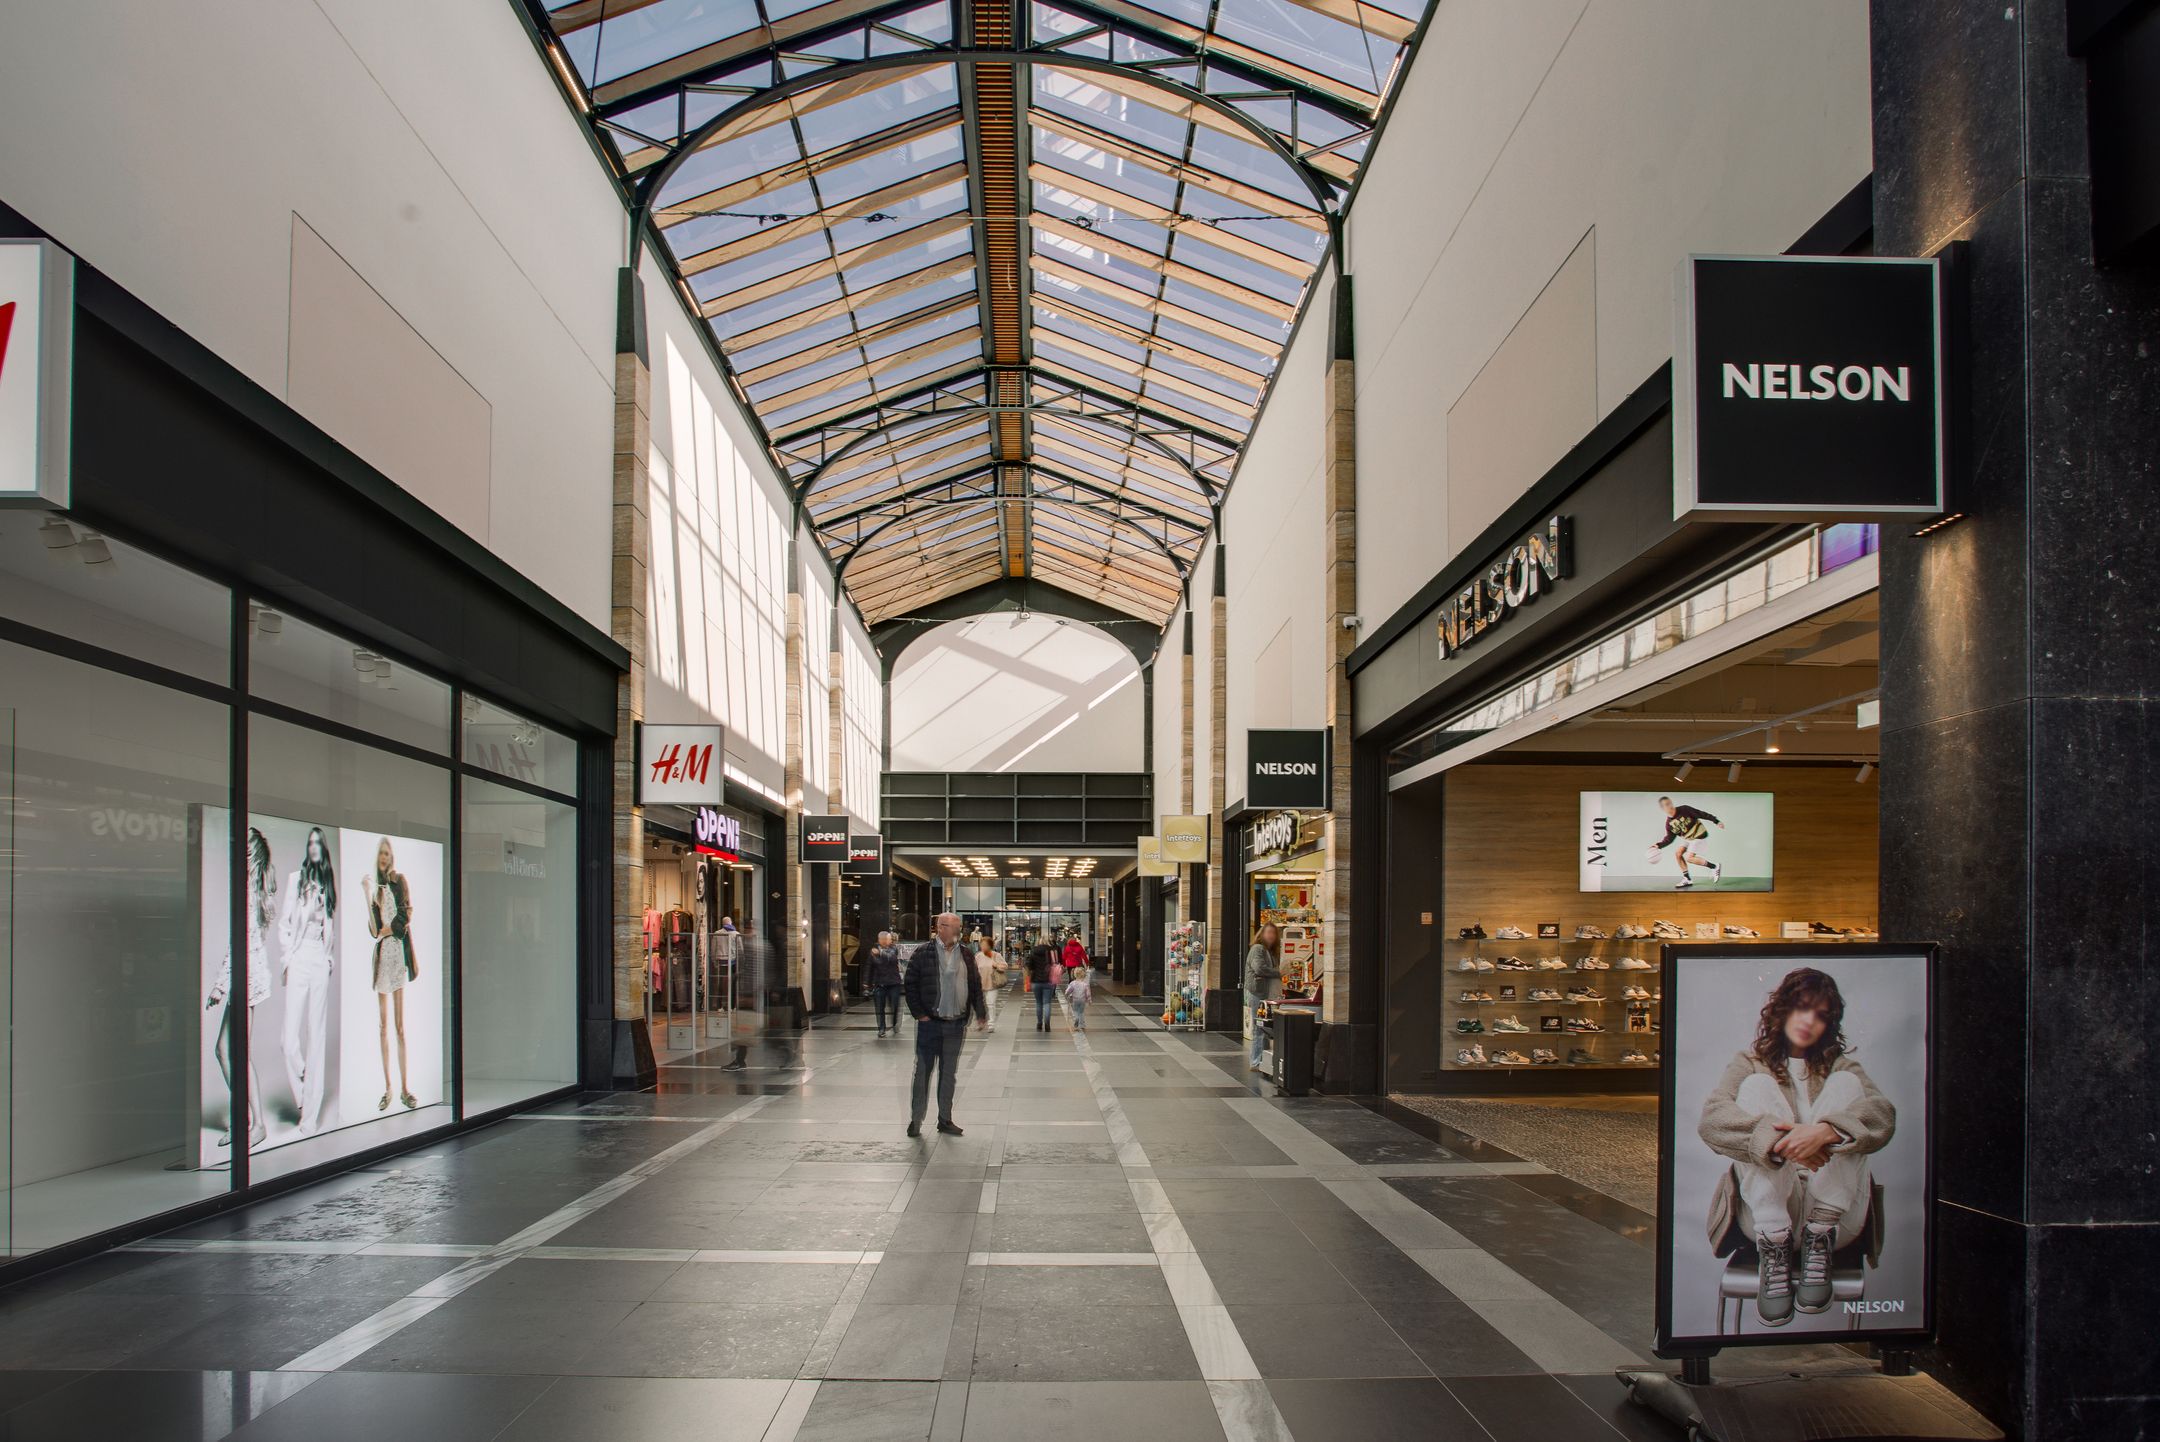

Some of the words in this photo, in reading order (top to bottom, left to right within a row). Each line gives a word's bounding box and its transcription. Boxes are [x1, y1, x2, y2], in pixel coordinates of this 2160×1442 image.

[1723, 363, 1910, 402] NELSON
[1438, 515, 1562, 660] NELSON
[652, 743, 713, 785] H&M
[1255, 762, 1317, 776] NELSON
[1166, 834, 1202, 842] Intertoys
[1253, 814, 1292, 855] Intertoys
[1587, 817, 1608, 867] Men
[1843, 1300, 1905, 1314] NELSON
